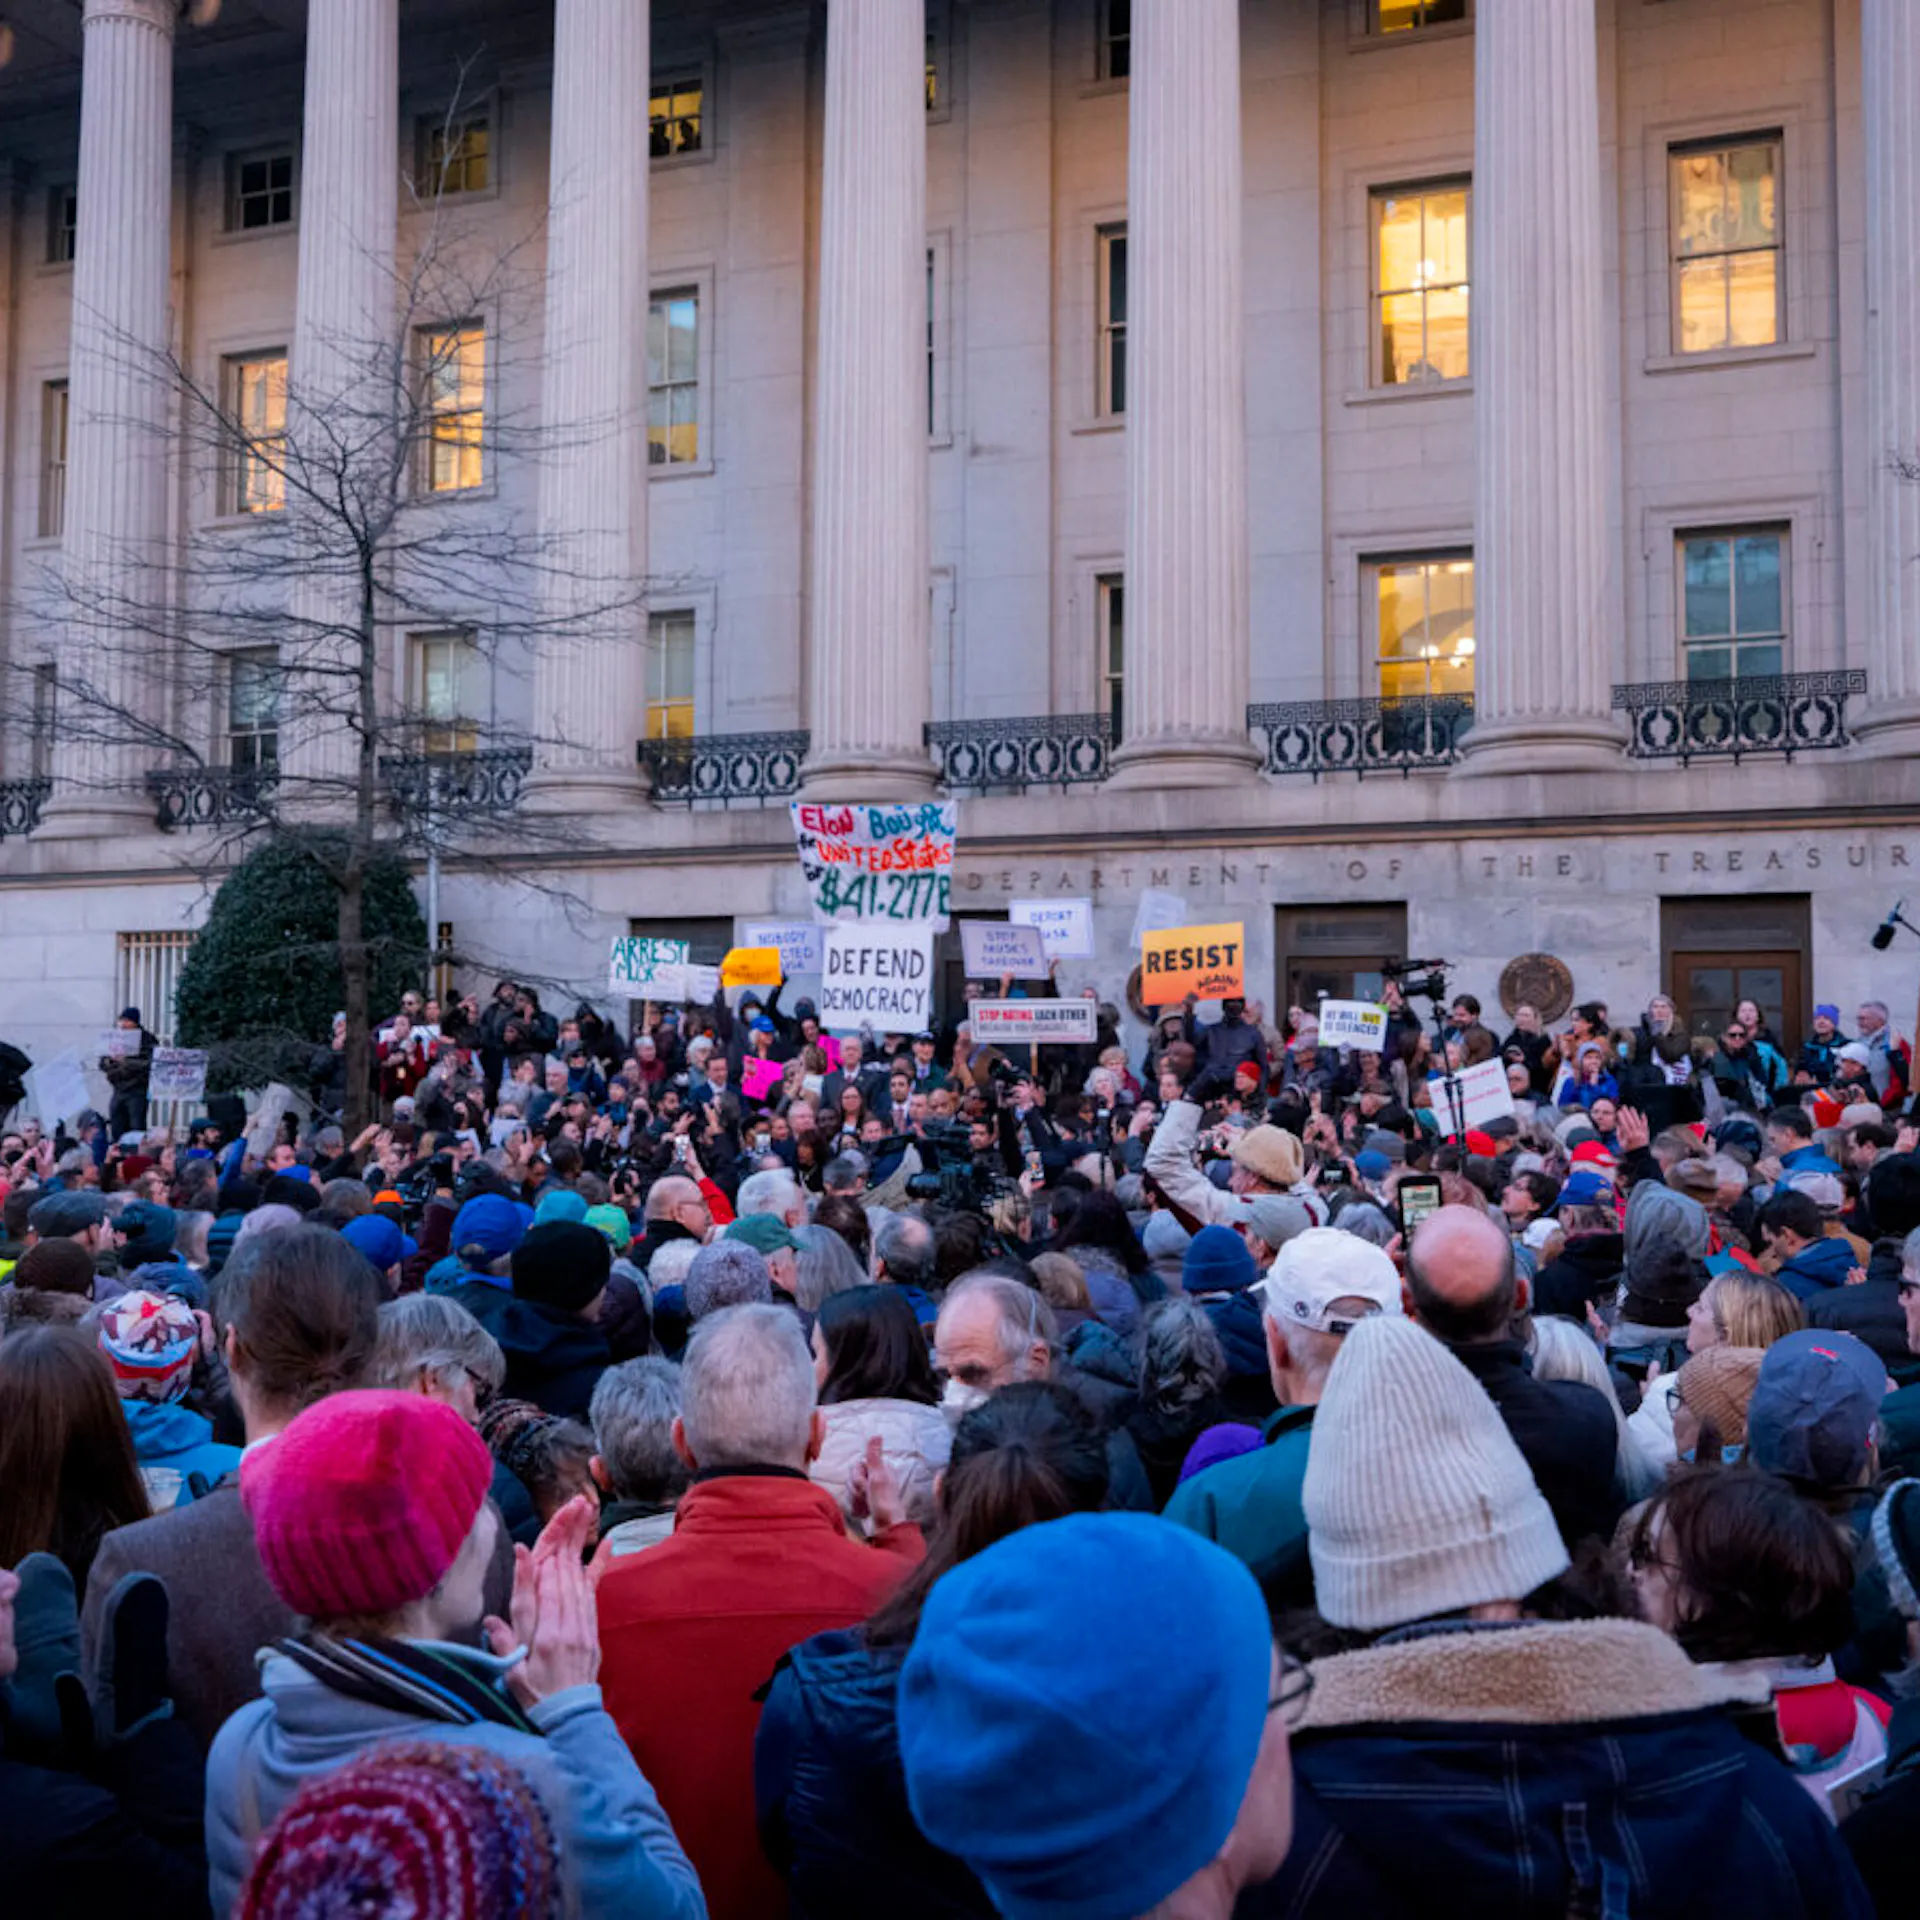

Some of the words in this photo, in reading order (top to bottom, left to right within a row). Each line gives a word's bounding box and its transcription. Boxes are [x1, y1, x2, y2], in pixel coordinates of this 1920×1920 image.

[966, 860, 1270, 891] DEPARTMENT
[1347, 859, 1401, 881] OF
[1481, 854, 1572, 878] THE
[1654, 844, 1910, 874] TREASUR
[612, 937, 687, 965] ARREST
[829, 947, 925, 980] DEFEND
[1146, 943, 1239, 974] RESIST
[822, 986, 927, 1015] DEMOCRACY
[979, 1008, 1000, 1021] STOP
[1002, 1008, 1033, 1021] HATING
[1035, 1008, 1057, 1020] EACH
[1060, 1008, 1087, 1020] OTHER
[1335, 1022, 1379, 1035] SILENCED
[1362, 1011, 1381, 1024] NOT
